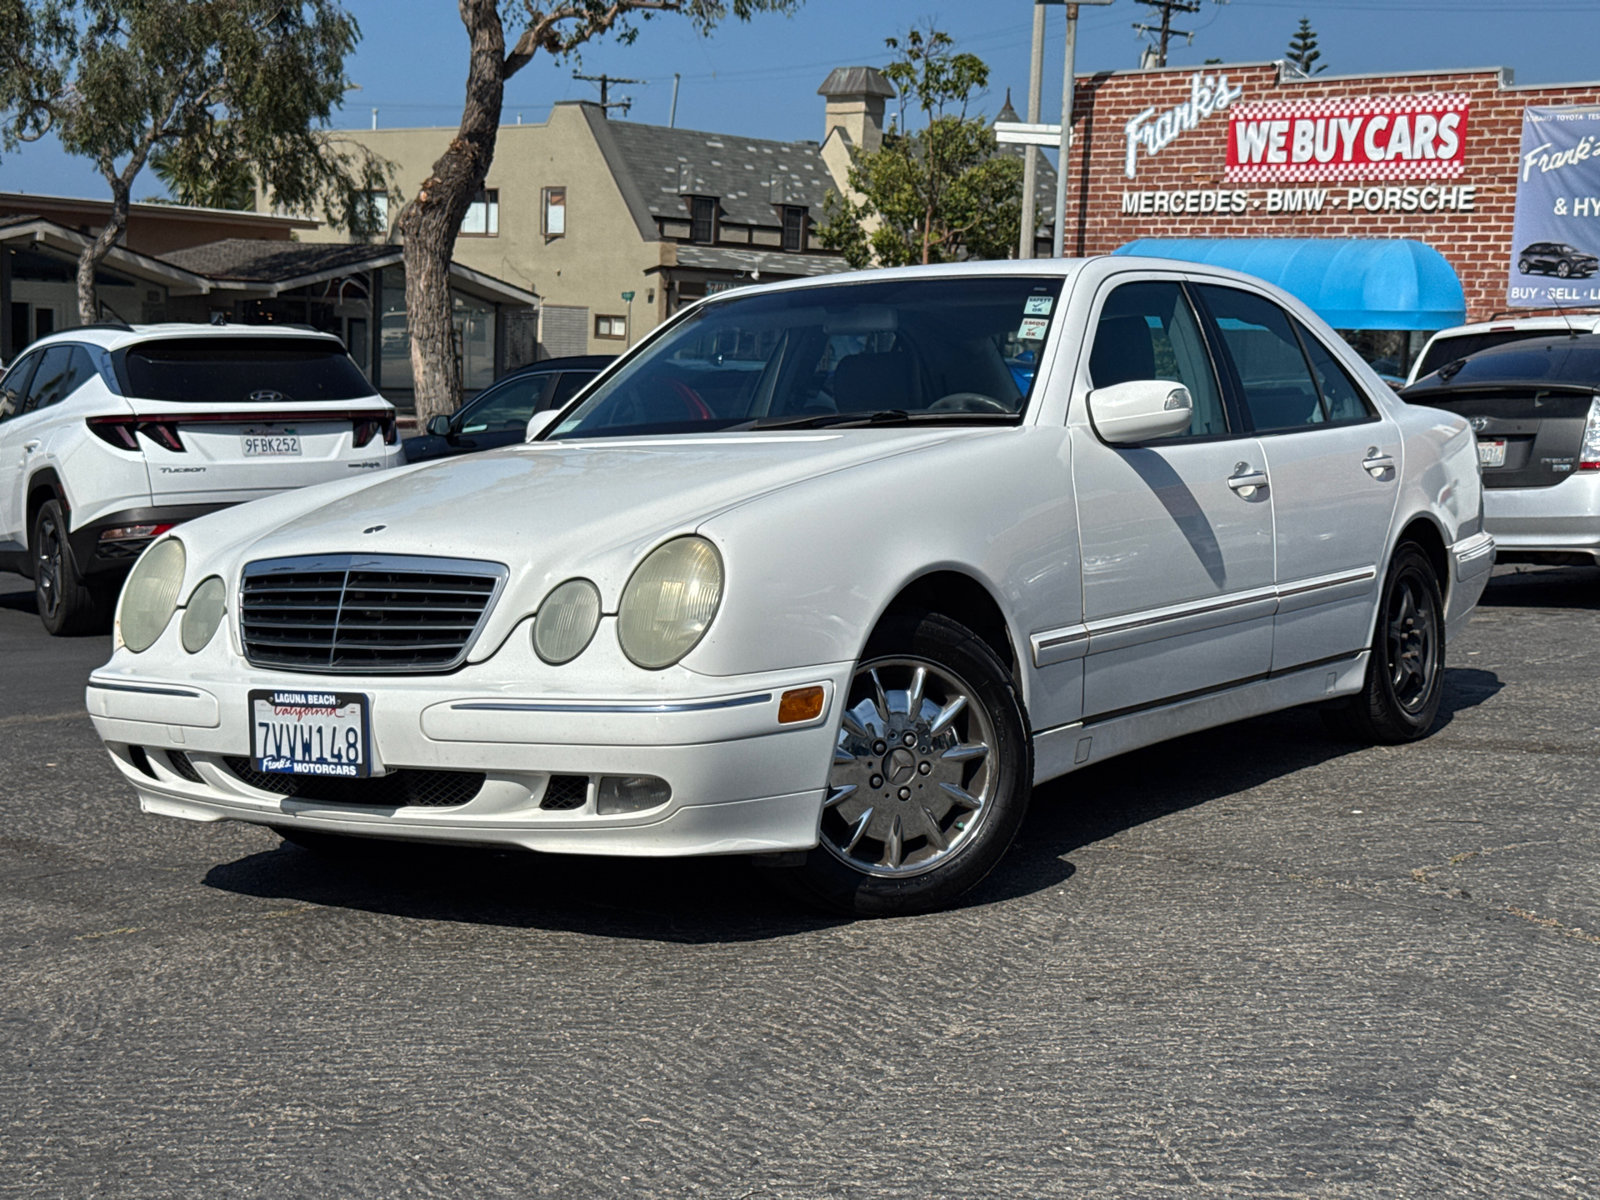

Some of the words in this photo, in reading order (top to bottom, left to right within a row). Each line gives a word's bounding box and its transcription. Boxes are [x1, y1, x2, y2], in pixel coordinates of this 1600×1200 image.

[1125, 73, 1242, 179] Frank's
[1235, 120, 1290, 164] WE
[1291, 117, 1365, 164] BUY
[1363, 112, 1461, 162] CARS
[1121, 189, 1248, 214] MERCEDES
[1267, 188, 1327, 213] BMW
[1347, 186, 1477, 212] PORSCHE
[1553, 197, 1567, 216] &
[1511, 287, 1538, 300] BUY
[1547, 288, 1580, 300] SELL
[245, 437, 298, 452] 9FBK252
[273, 692, 307, 704] LAGUNA
[307, 694, 336, 705] BEACH
[258, 722, 359, 763] 7VVW148
[262, 756, 293, 772] Frank's
[293, 762, 357, 775] MOTORCARS
